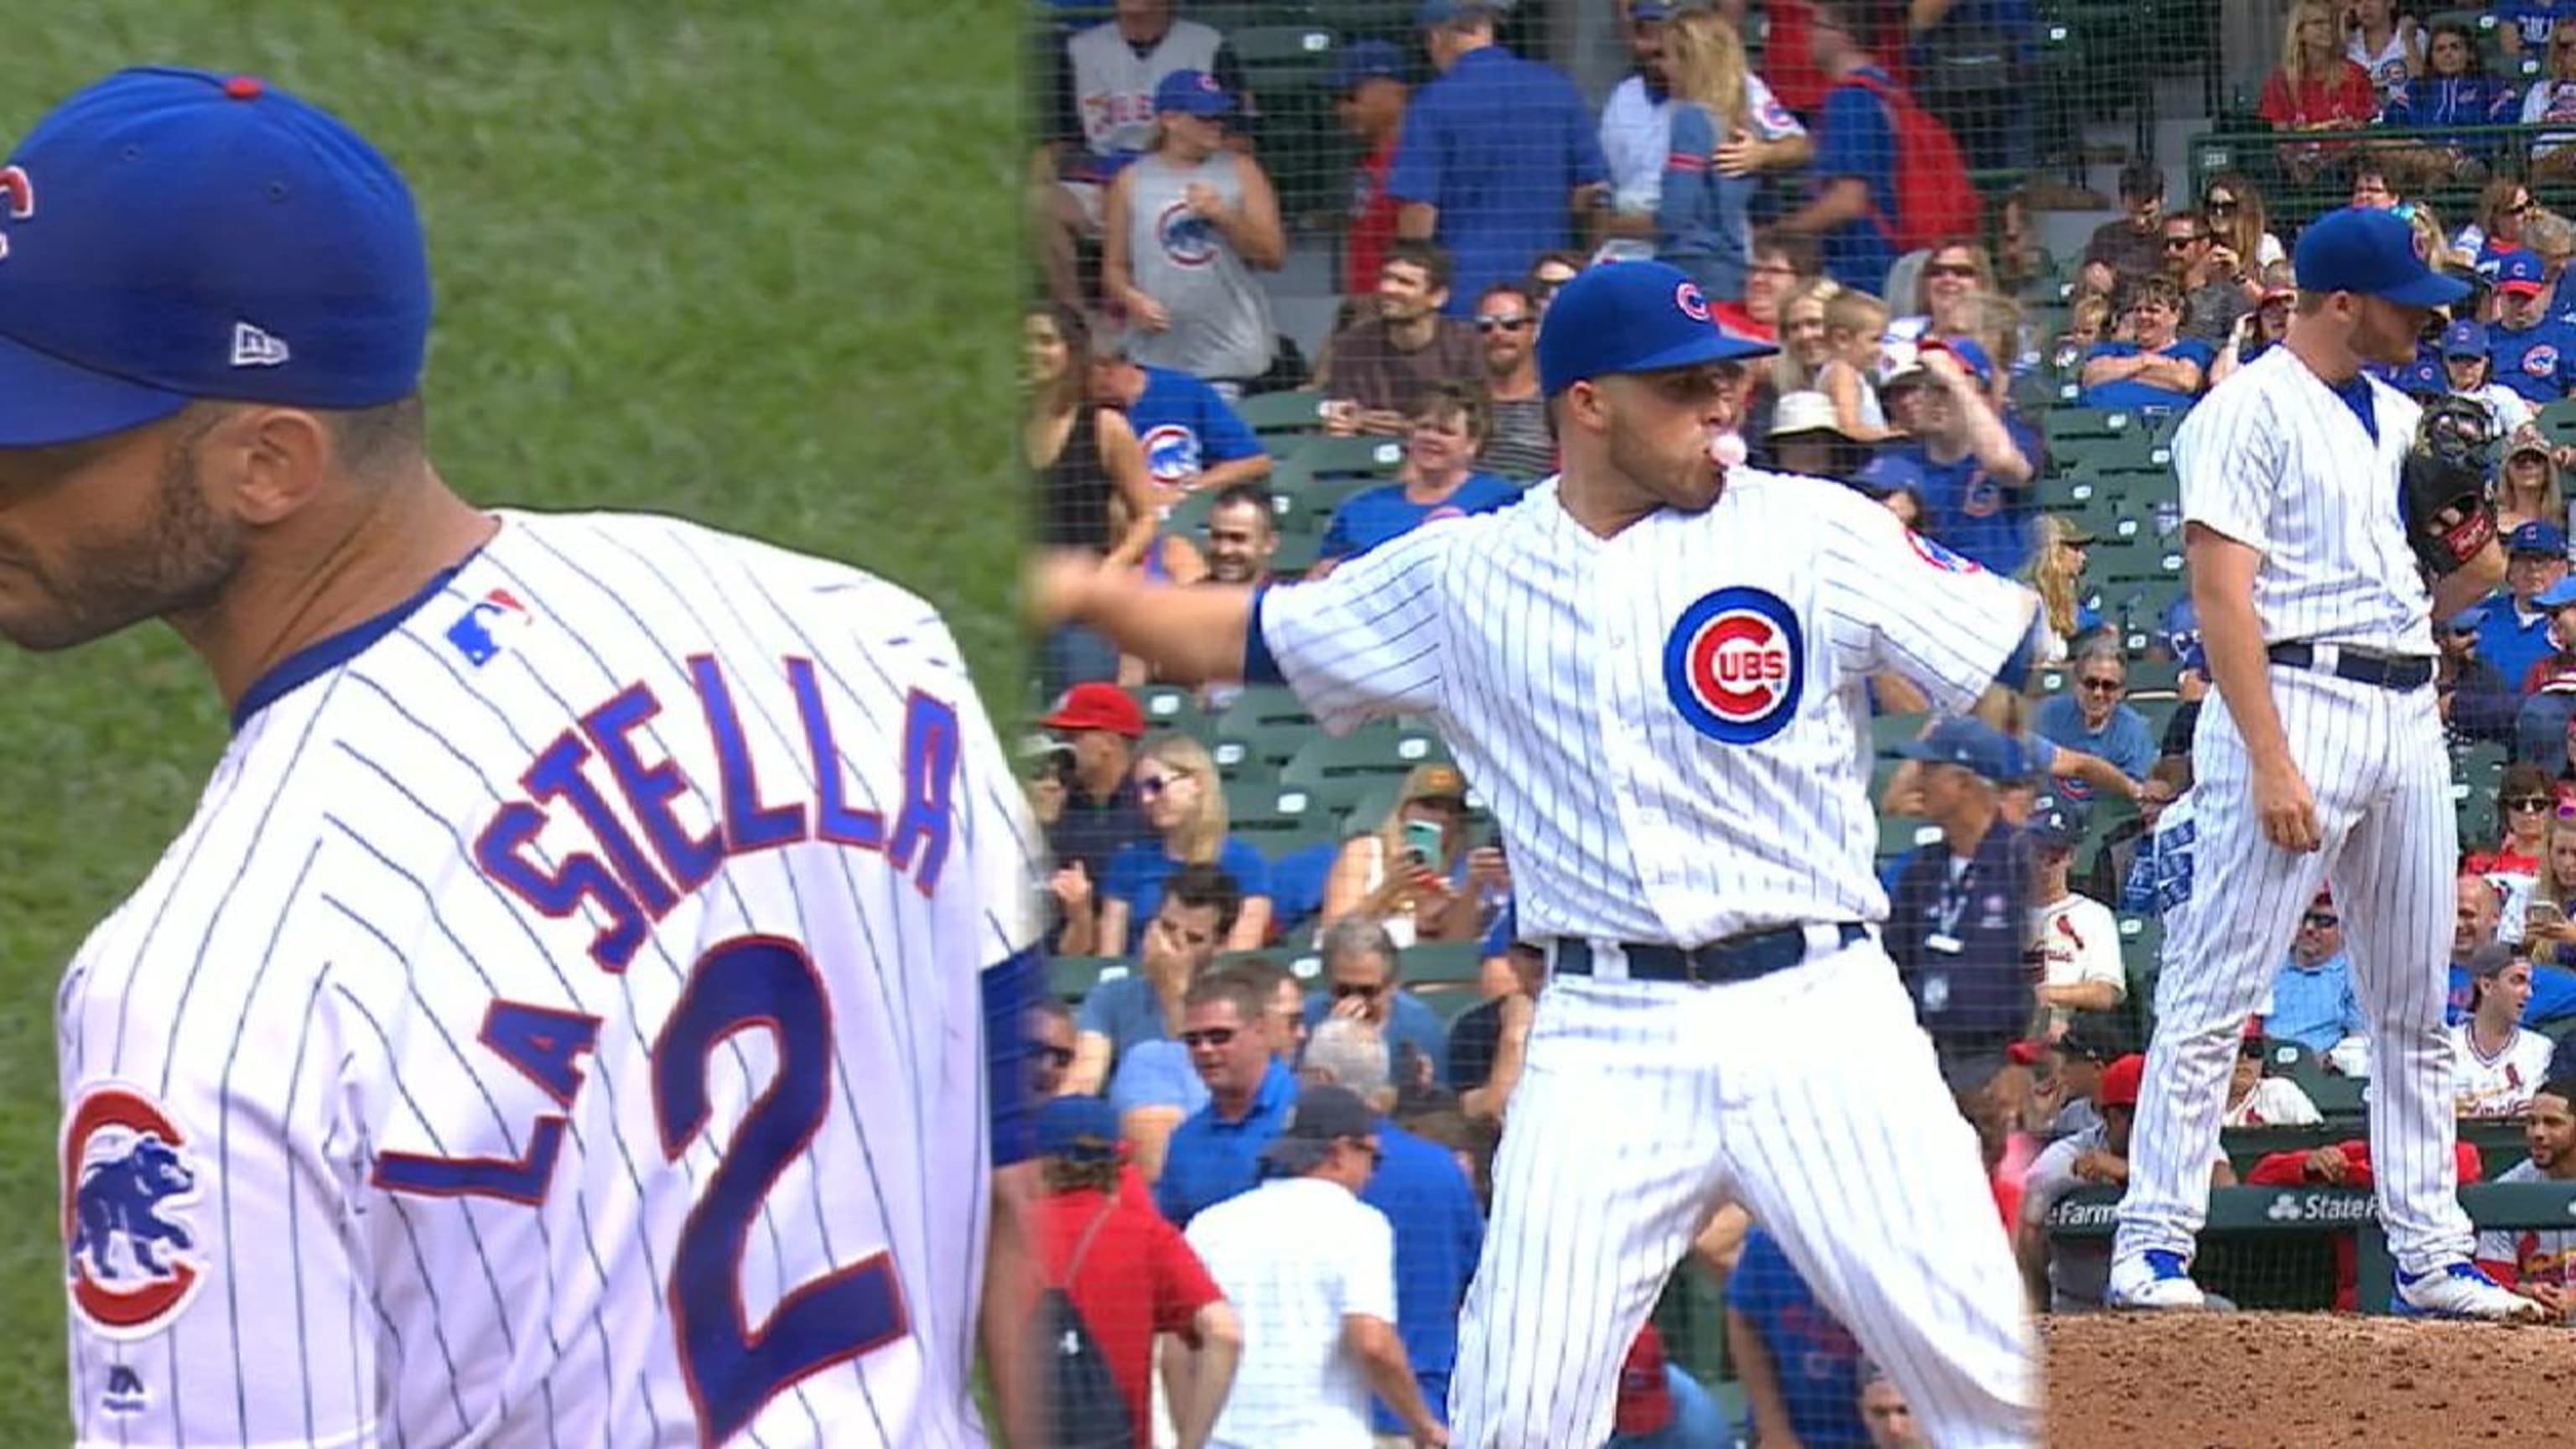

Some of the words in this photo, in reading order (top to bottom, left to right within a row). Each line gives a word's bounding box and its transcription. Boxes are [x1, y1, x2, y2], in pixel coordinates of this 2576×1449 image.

[474, 652, 960, 974] STELLA
[371, 998, 604, 1207] LA
[651, 932, 908, 1449] 2
